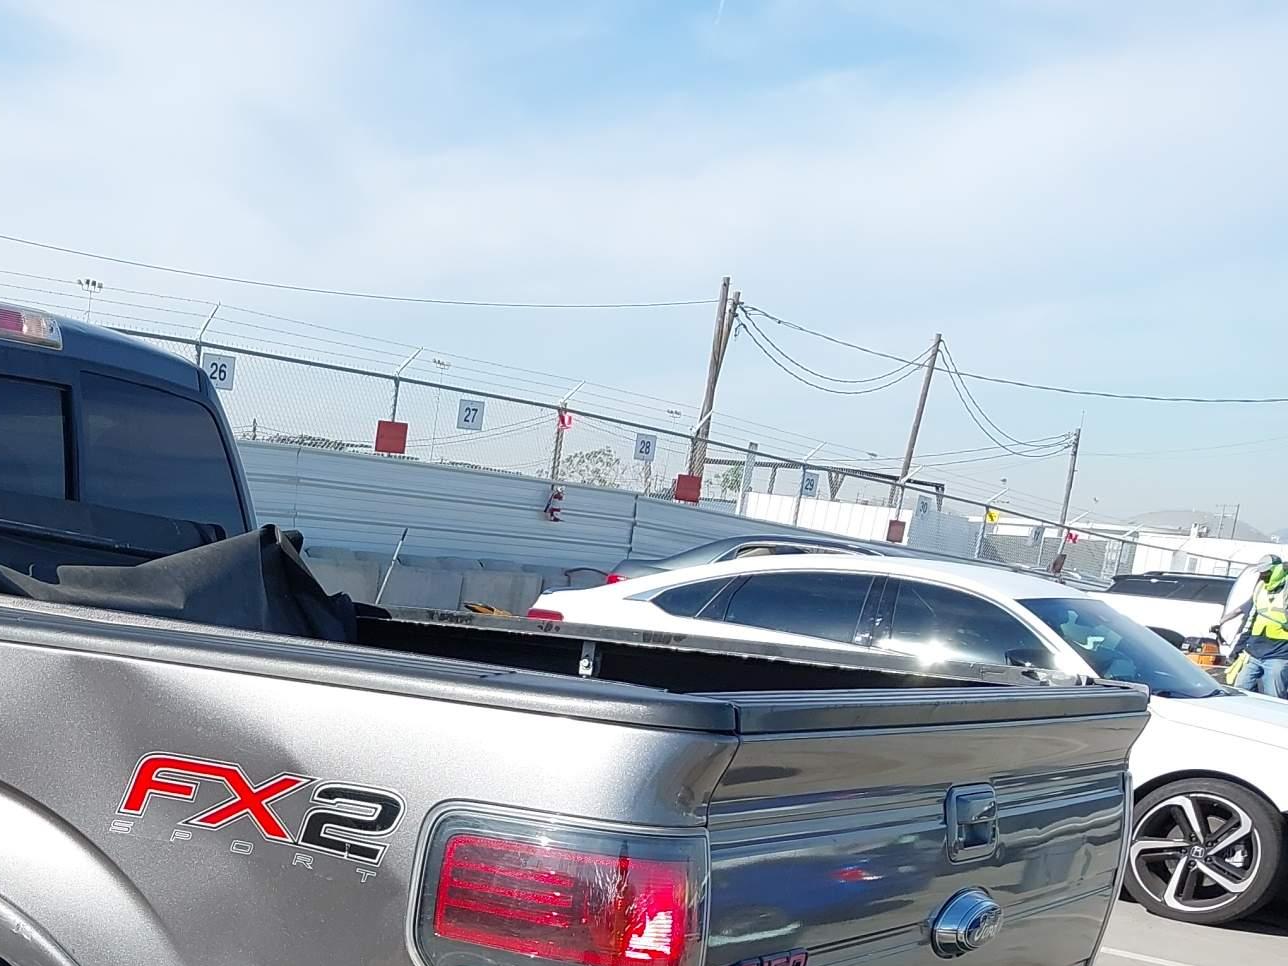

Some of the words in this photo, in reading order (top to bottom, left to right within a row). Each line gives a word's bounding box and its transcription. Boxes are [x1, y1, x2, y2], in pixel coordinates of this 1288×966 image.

[210, 362, 227, 381] 26
[464, 407, 478, 423] 27
[640, 440, 651, 455] 28
[805, 478, 815, 491] 29
[116, 751, 407, 867] FX2
[109, 819, 376, 882] SPORT
